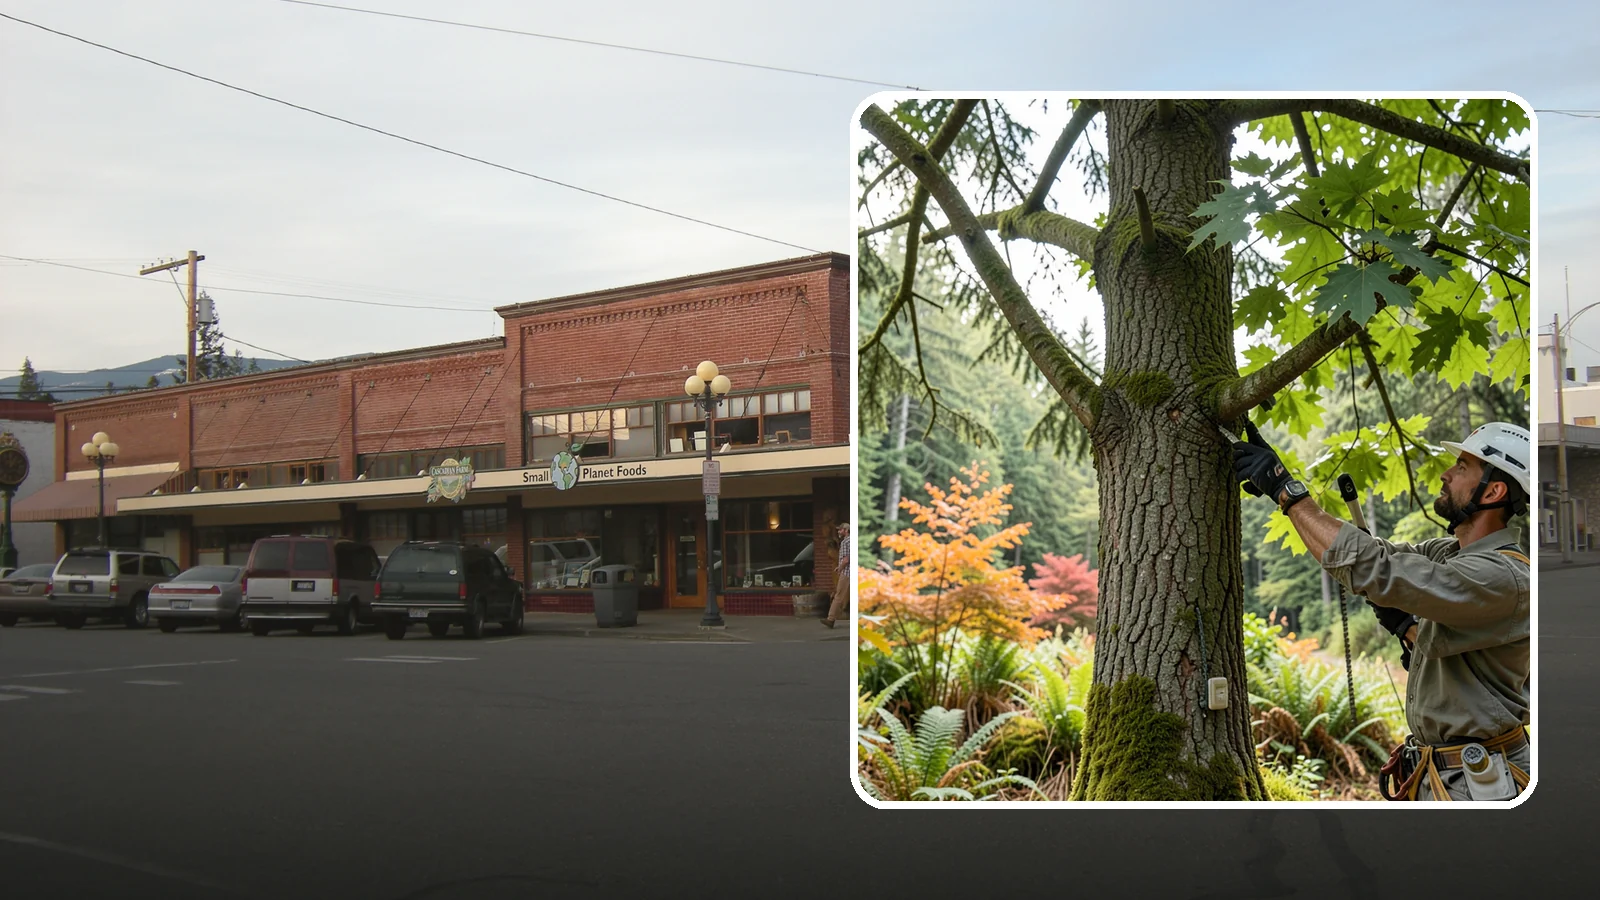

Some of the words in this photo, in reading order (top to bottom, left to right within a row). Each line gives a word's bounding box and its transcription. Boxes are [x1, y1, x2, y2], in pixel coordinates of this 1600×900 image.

[523, 471, 549, 483] Small
[583, 467, 614, 479] Planet
[617, 464, 647, 477] Foods
